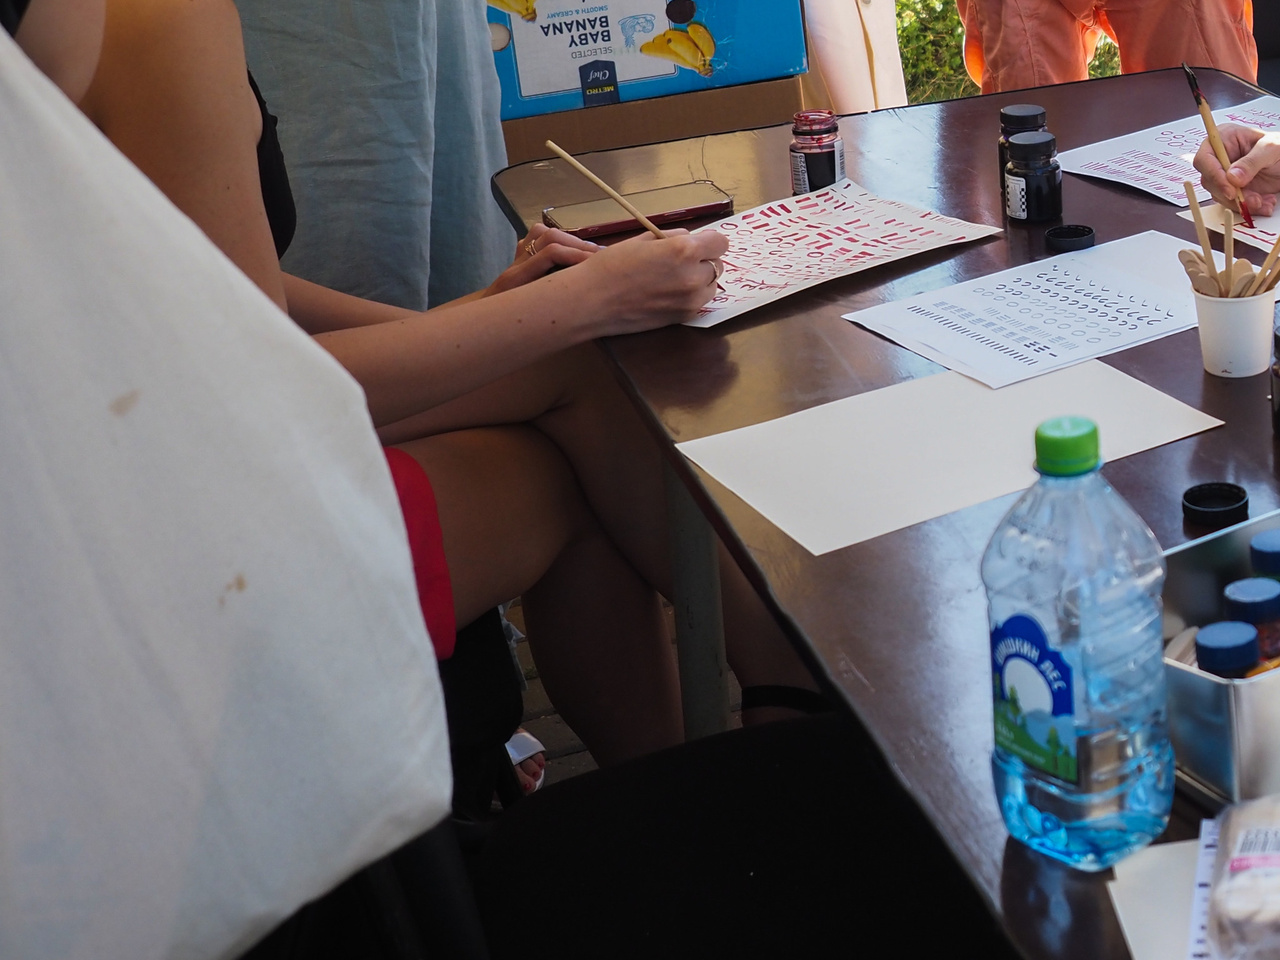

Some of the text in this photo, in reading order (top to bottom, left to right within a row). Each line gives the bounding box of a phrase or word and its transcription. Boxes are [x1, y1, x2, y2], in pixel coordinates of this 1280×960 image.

[546, 9, 574, 19] CREAMY
[581, 4, 609, 14] SMOOTH
[540, 15, 610, 37] BANANA
[568, 29, 612, 48] BABY
[571, 46, 613, 59] SELECTED
[588, 69, 609, 82] Chef
[586, 85, 614, 95] METRO
